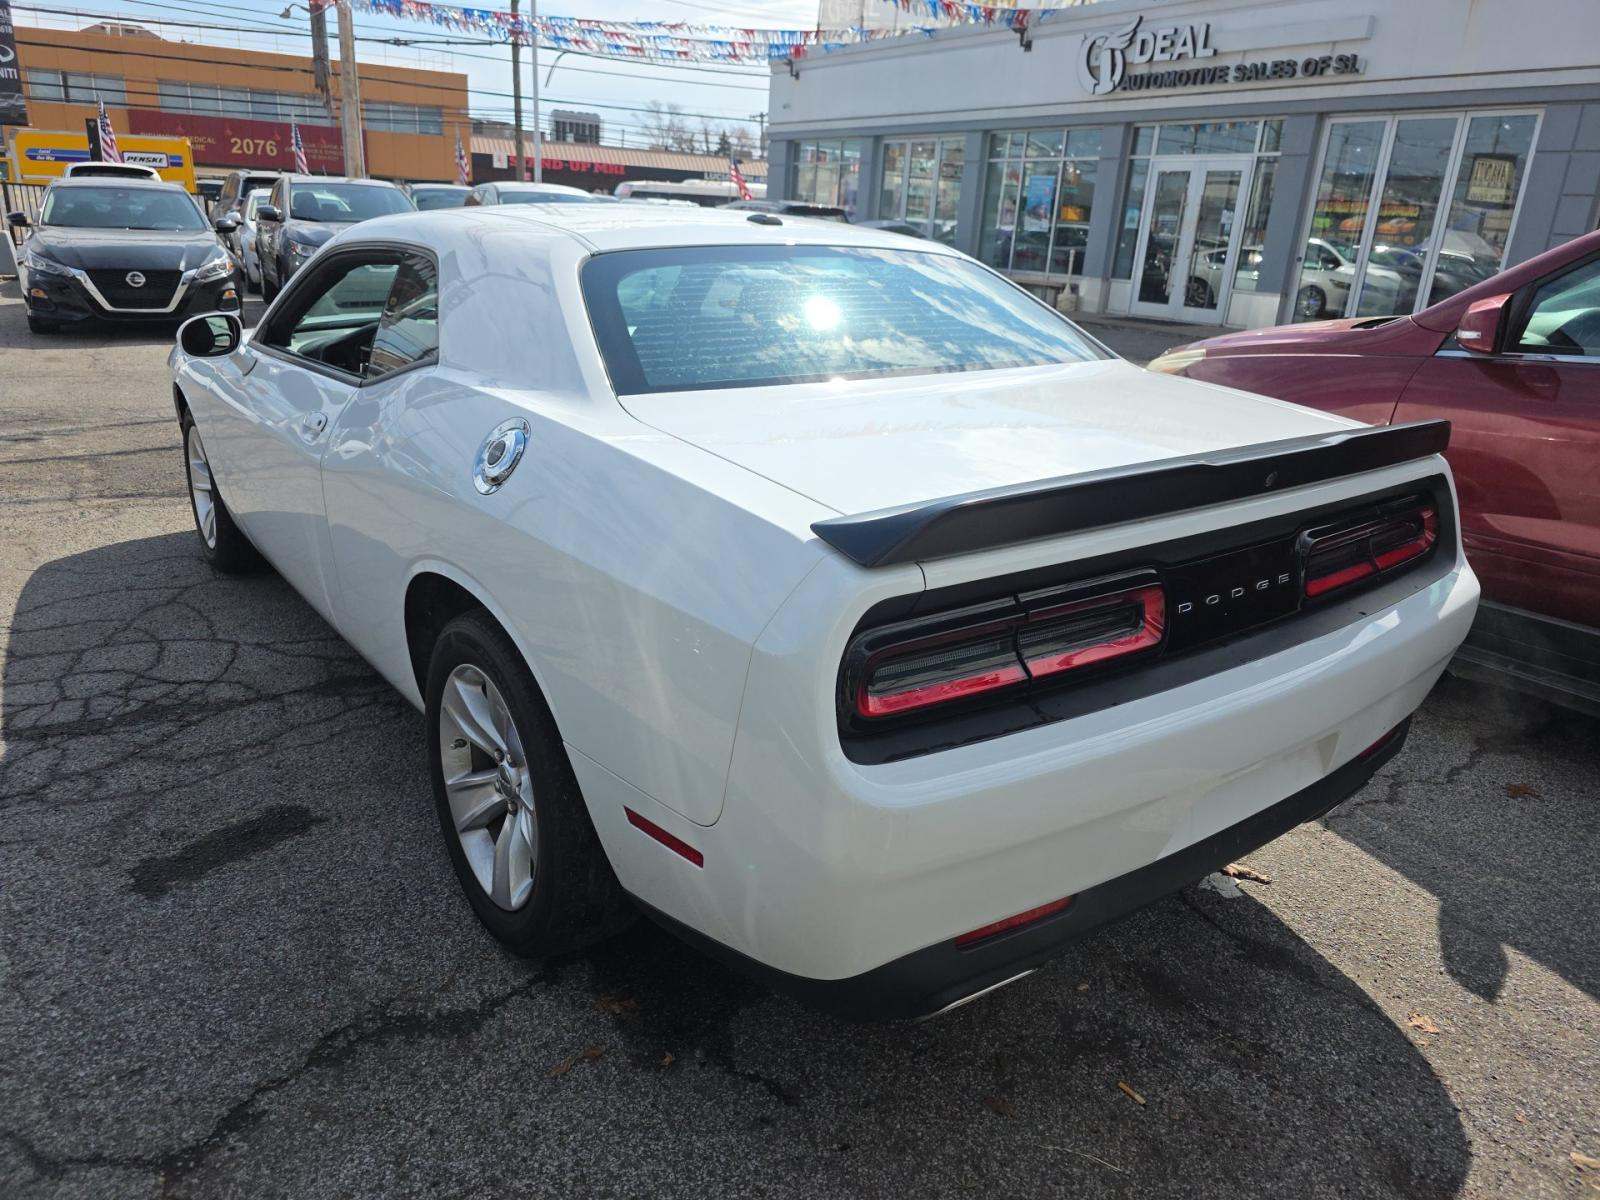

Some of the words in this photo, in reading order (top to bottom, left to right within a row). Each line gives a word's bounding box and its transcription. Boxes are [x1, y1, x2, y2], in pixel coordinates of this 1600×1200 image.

[1132, 23, 1217, 64] DEAL
[1121, 65, 1230, 91] AUTOMOTIVE
[1234, 59, 1298, 82] SALES
[1301, 56, 1332, 77] OF
[230, 137, 278, 157] 2076
[1178, 573, 1291, 614] DODGE
